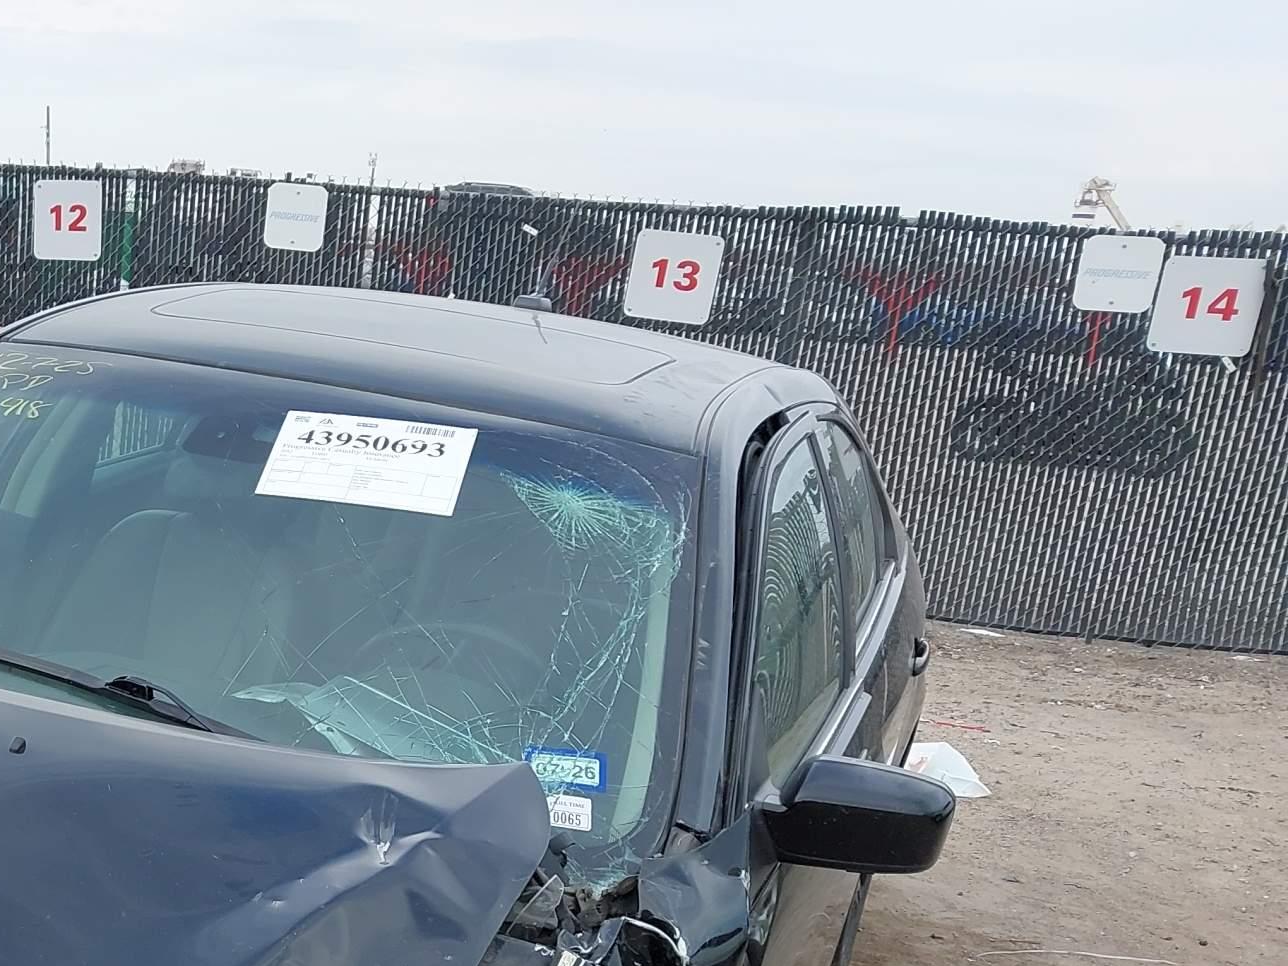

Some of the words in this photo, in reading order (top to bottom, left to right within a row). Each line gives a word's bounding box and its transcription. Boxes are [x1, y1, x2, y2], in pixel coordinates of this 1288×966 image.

[50, 204, 88, 232] 12
[652, 258, 701, 292] 13
[1083, 267, 1153, 280] PROGRESSIVE
[1182, 287, 1239, 321] 14
[297, 429, 446, 458] 43950693
[553, 811, 582, 826] 0065
